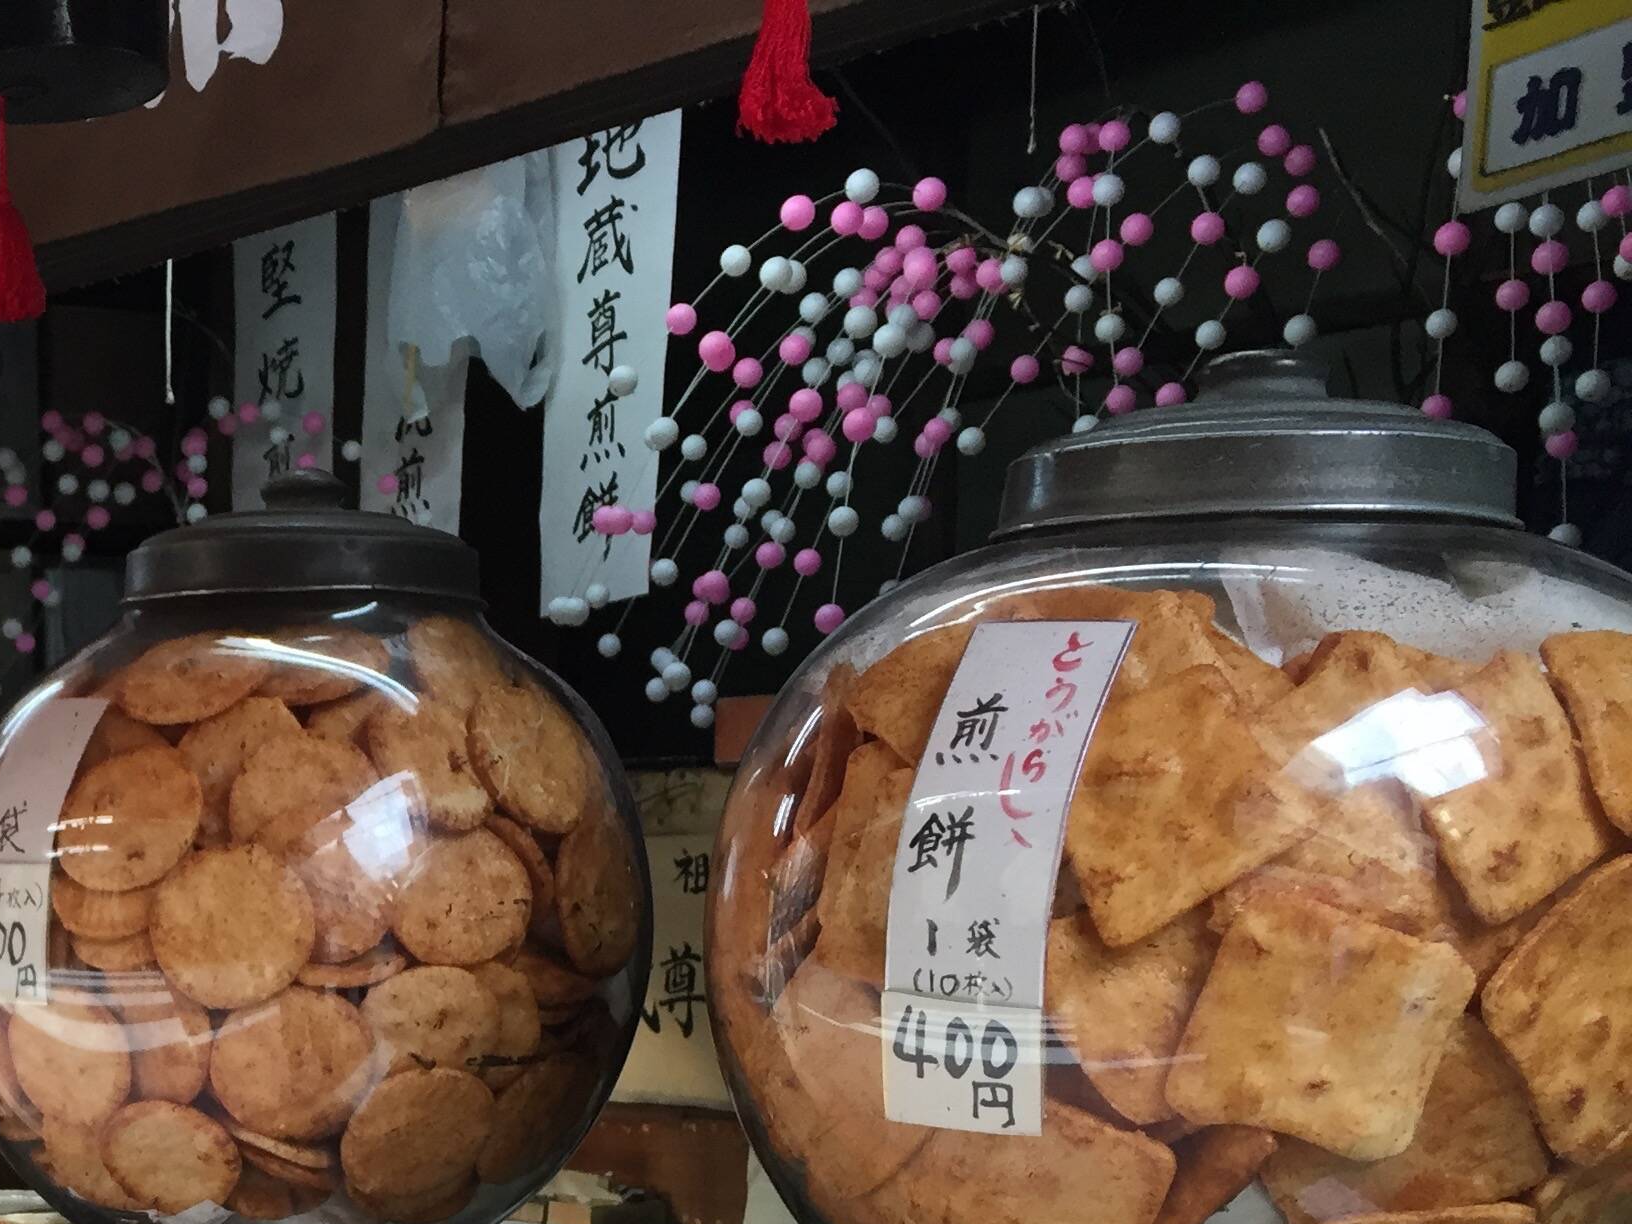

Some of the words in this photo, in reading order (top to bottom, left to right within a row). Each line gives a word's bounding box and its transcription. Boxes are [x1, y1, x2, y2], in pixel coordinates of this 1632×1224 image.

[572, 117, 647, 562] 地蔵尊煎餅
[908, 692, 1008, 901] 煎餅
[926, 918, 1001, 959] 1袋
[892, 1004, 1018, 1129] 400円
